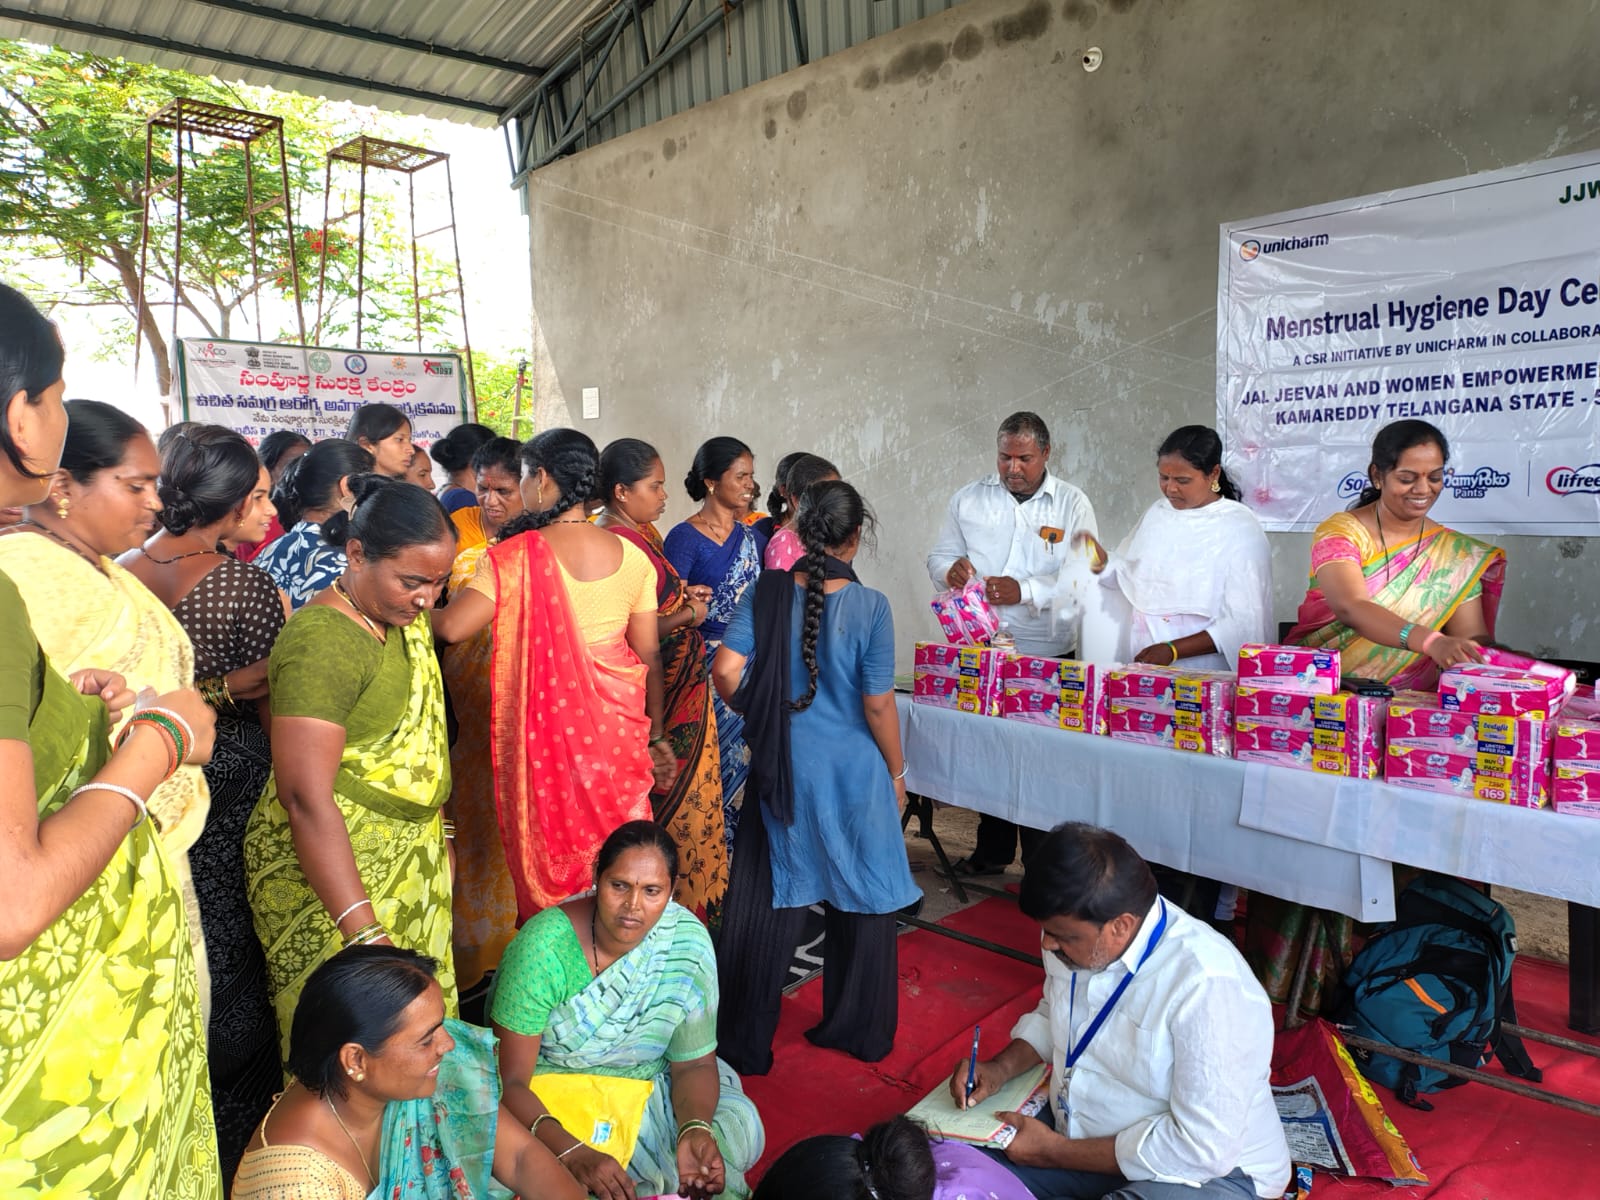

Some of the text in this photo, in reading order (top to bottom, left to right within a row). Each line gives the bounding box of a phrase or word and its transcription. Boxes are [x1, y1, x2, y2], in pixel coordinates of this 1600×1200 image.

[1263, 234, 1330, 254] unicharm
[1266, 278, 1600, 342] Menstrual Hygiene Day Ce
[1293, 355, 1301, 366] A
[1304, 352, 1327, 365] CSR
[1331, 345, 1392, 363] INITIATIVE
[1395, 343, 1412, 356] BY
[1416, 336, 1487, 354] UNICHARM
[1492, 333, 1506, 347] IN
[315, 375, 364, 398] సురక్ష
[366, 376, 417, 398] కేంద్రం
[1242, 361, 1600, 405] JAL JEEVAN AND WOMEN EMPOWERME
[1276, 404, 1381, 425] KAMAREDDY
[1386, 396, 1503, 418] TELANGANA
[1509, 390, 1575, 411] STATE
[1344, 478, 1370, 491] SOF
[1455, 488, 1484, 498] Pants
[1497, 755, 1505, 766] 4
